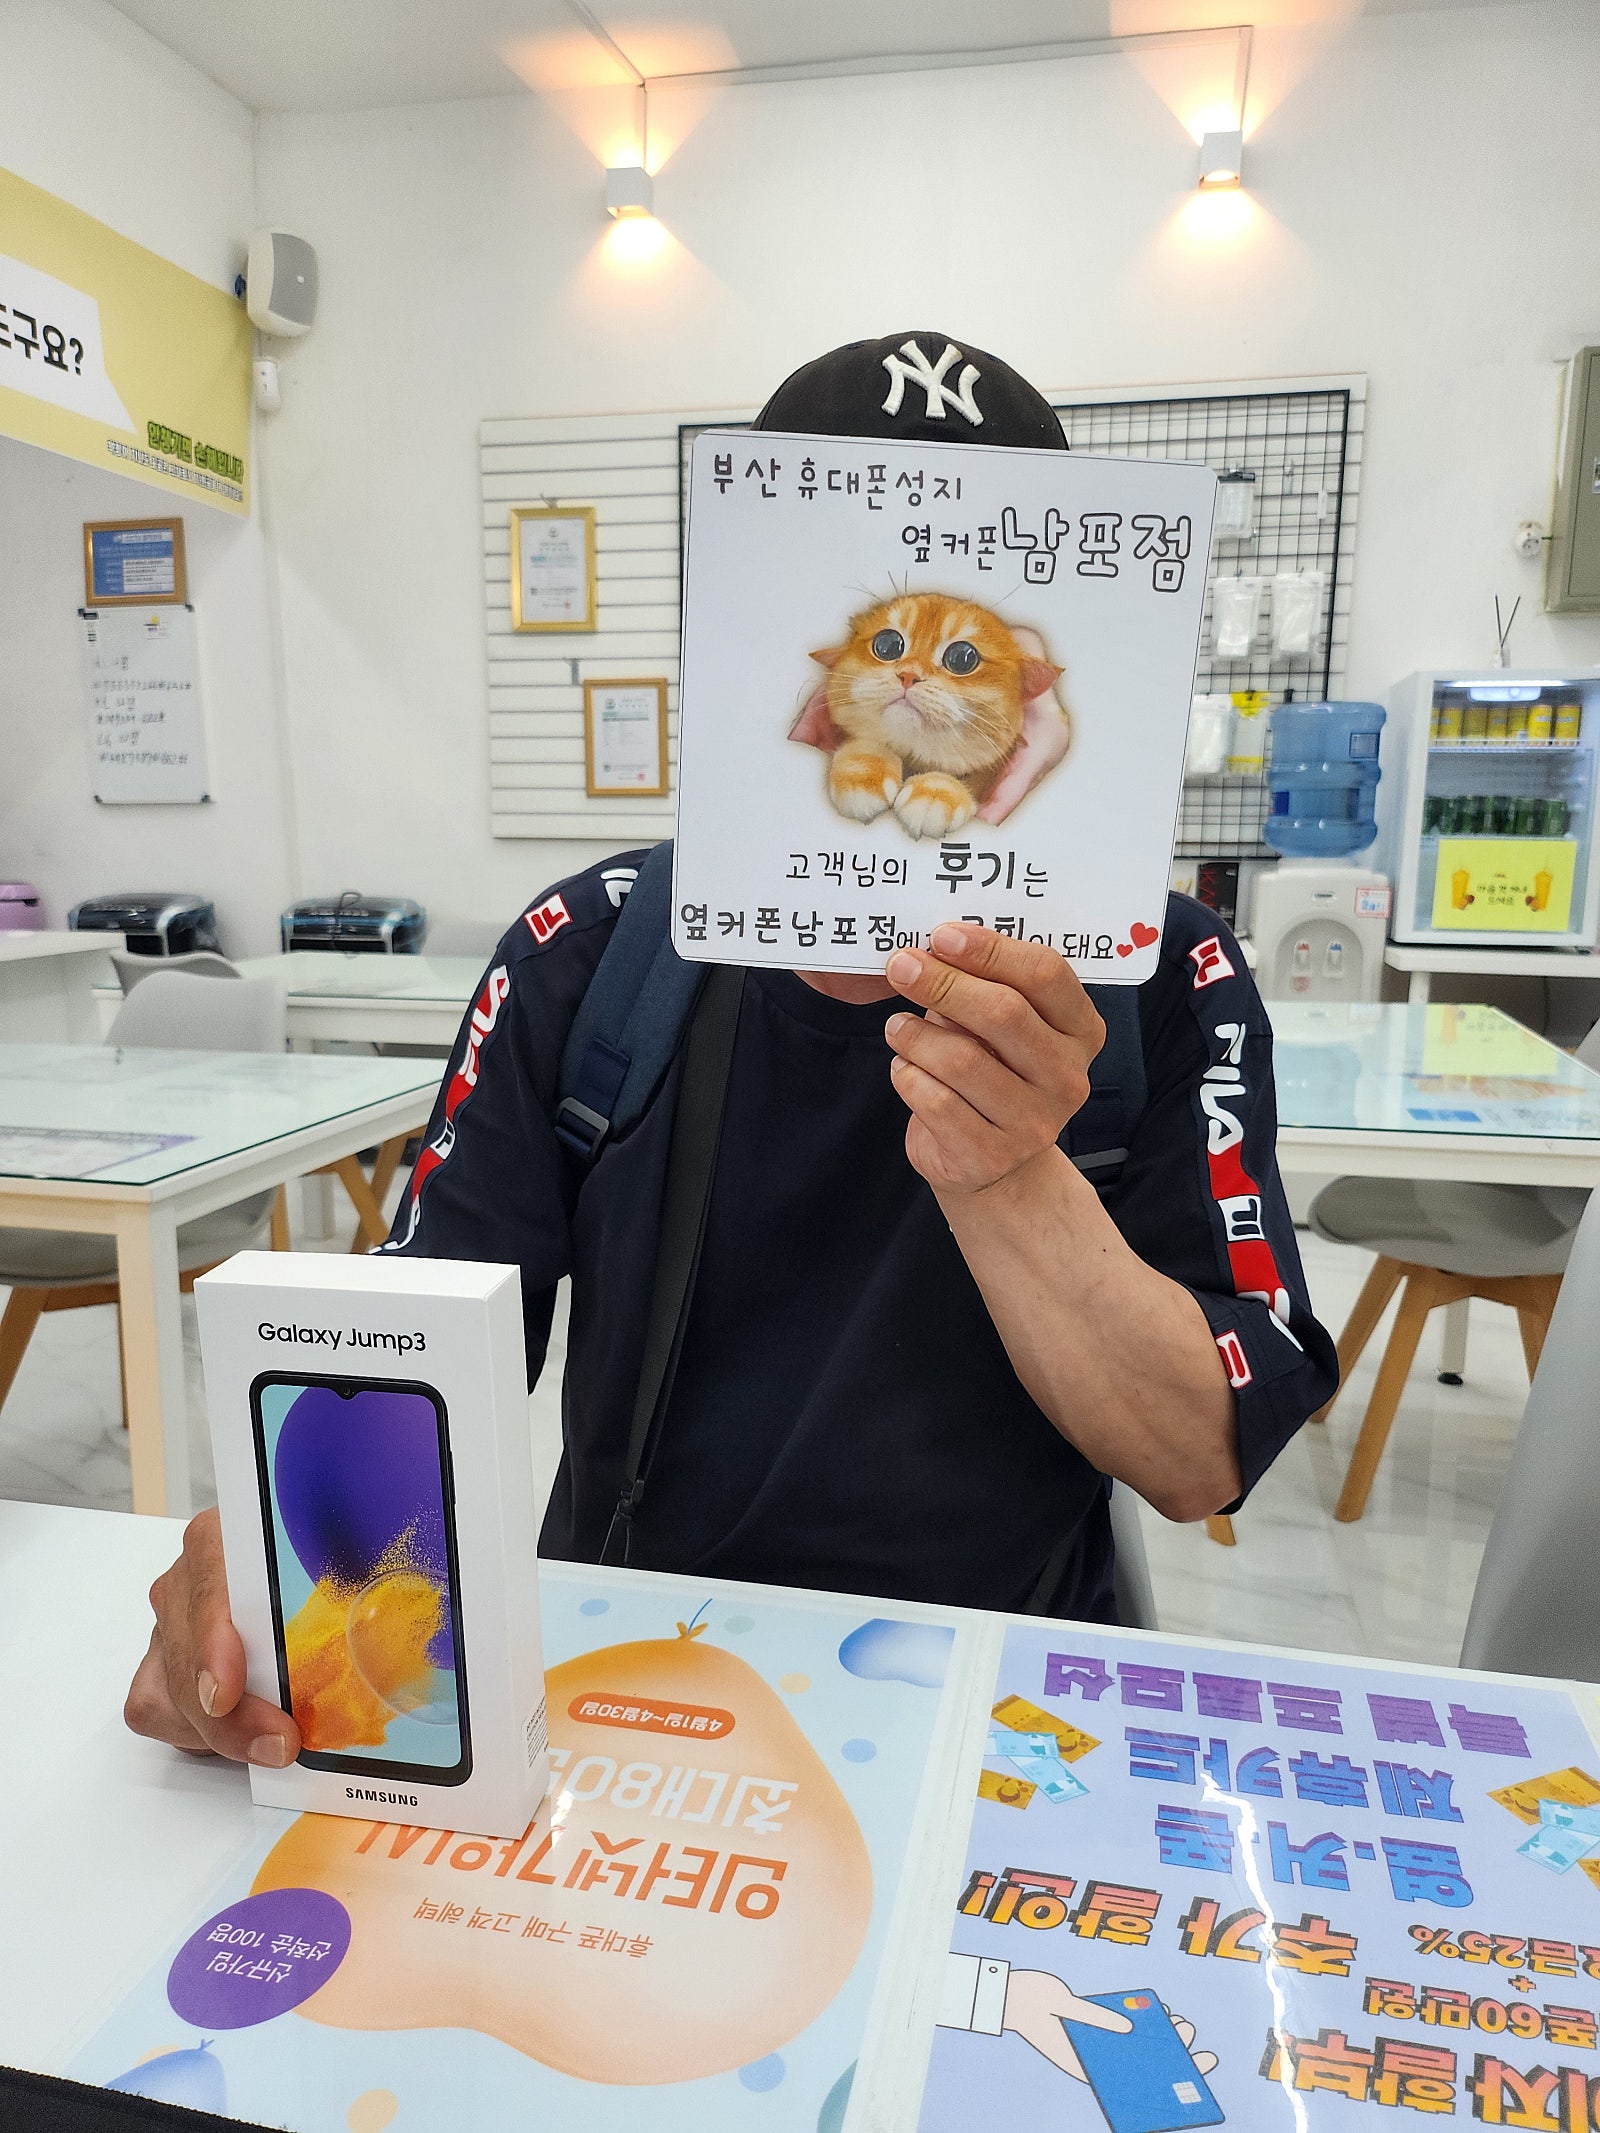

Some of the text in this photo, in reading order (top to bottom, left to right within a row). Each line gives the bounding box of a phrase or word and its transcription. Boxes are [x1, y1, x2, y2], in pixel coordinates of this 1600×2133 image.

[713, 453, 963, 512] 부산 휴대폰성지
[785, 842, 1049, 898] 고객님의 후기는
[1061, 932, 1115, 960] 돼요
[257, 1321, 427, 1357] Galaxy Jump3
[579, 1701, 724, 1733] 4월1일~4월30일
[1043, 1652, 1344, 1735] 프로모션
[345, 1787, 419, 1808] SAMSUNG
[1124, 1727, 1465, 1824] 제휴카드
[205, 1923, 332, 1961] 선착순 100명
[412, 1896, 654, 1959] 휴대폰 구매 고객 혜택
[957, 1867, 1359, 1978] 추가 할인!
[205, 1951, 293, 1984] 신규가입
[1248, 2027, 1458, 2117] 할부!
